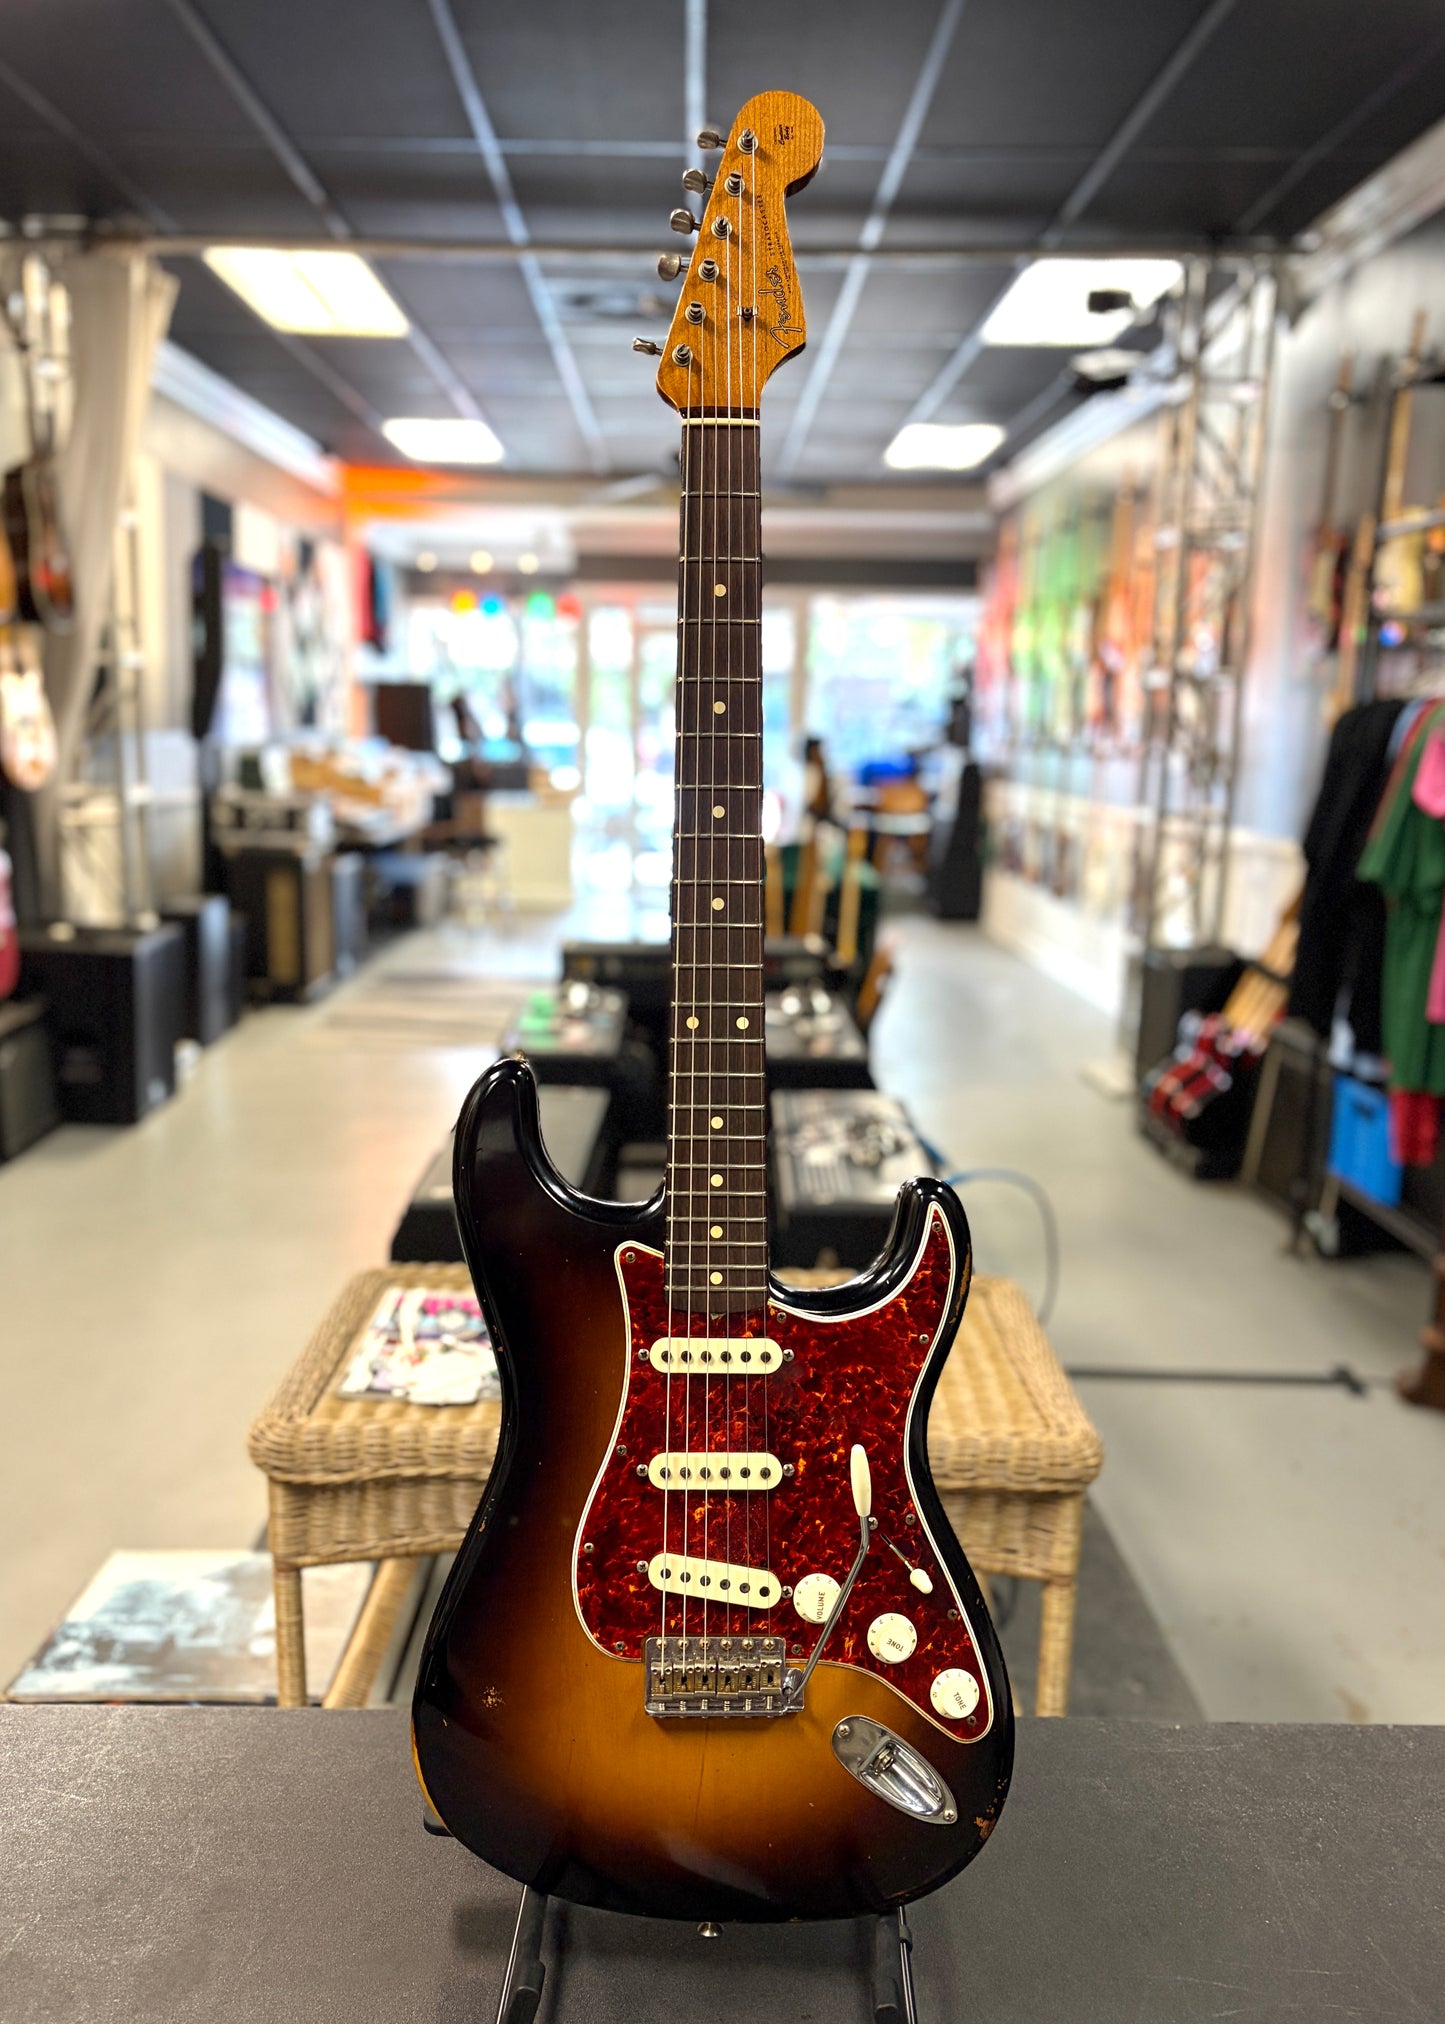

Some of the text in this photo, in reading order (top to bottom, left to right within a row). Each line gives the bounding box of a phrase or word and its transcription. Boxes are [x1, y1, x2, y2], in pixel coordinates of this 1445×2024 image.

[756, 194, 776, 257] STRATOCASTER
[757, 264, 803, 349] Fender
[816, 1591, 826, 1620] VOLUME
[886, 1637, 905, 1652] TONE
[953, 1691, 967, 1711] TONE
